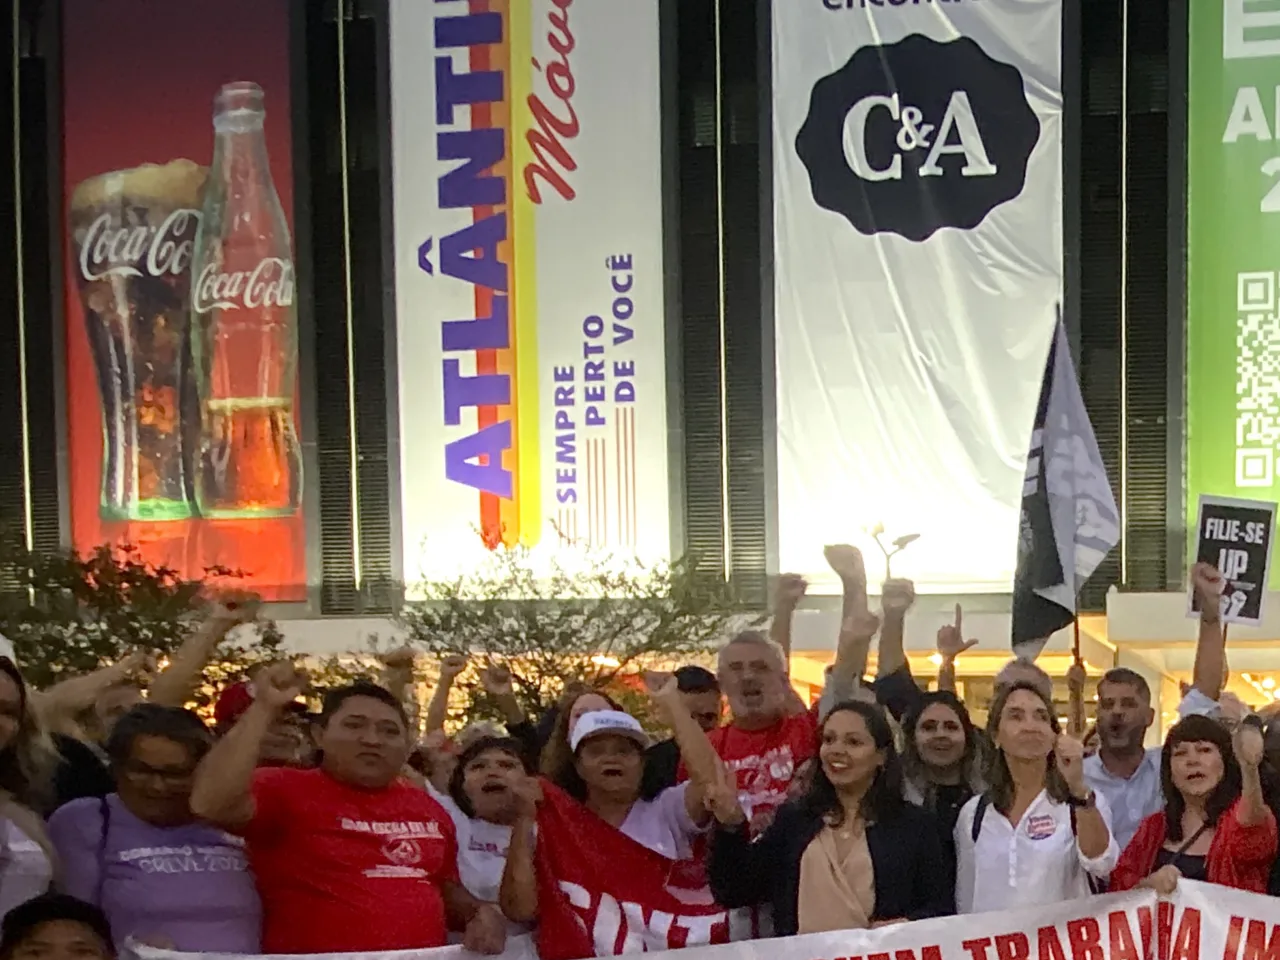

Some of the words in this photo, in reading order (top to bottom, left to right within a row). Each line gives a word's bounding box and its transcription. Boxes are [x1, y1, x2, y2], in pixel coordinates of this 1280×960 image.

[841, 90, 998, 181] C&A
[606, 254, 634, 346] VOCÊ
[583, 315, 606, 425] PERTO
[614, 360, 635, 402] DE
[554, 365, 577, 503] SEMPRE
[1205, 517, 1265, 544] FILIE-SE
[1219, 547, 1249, 580] UP
